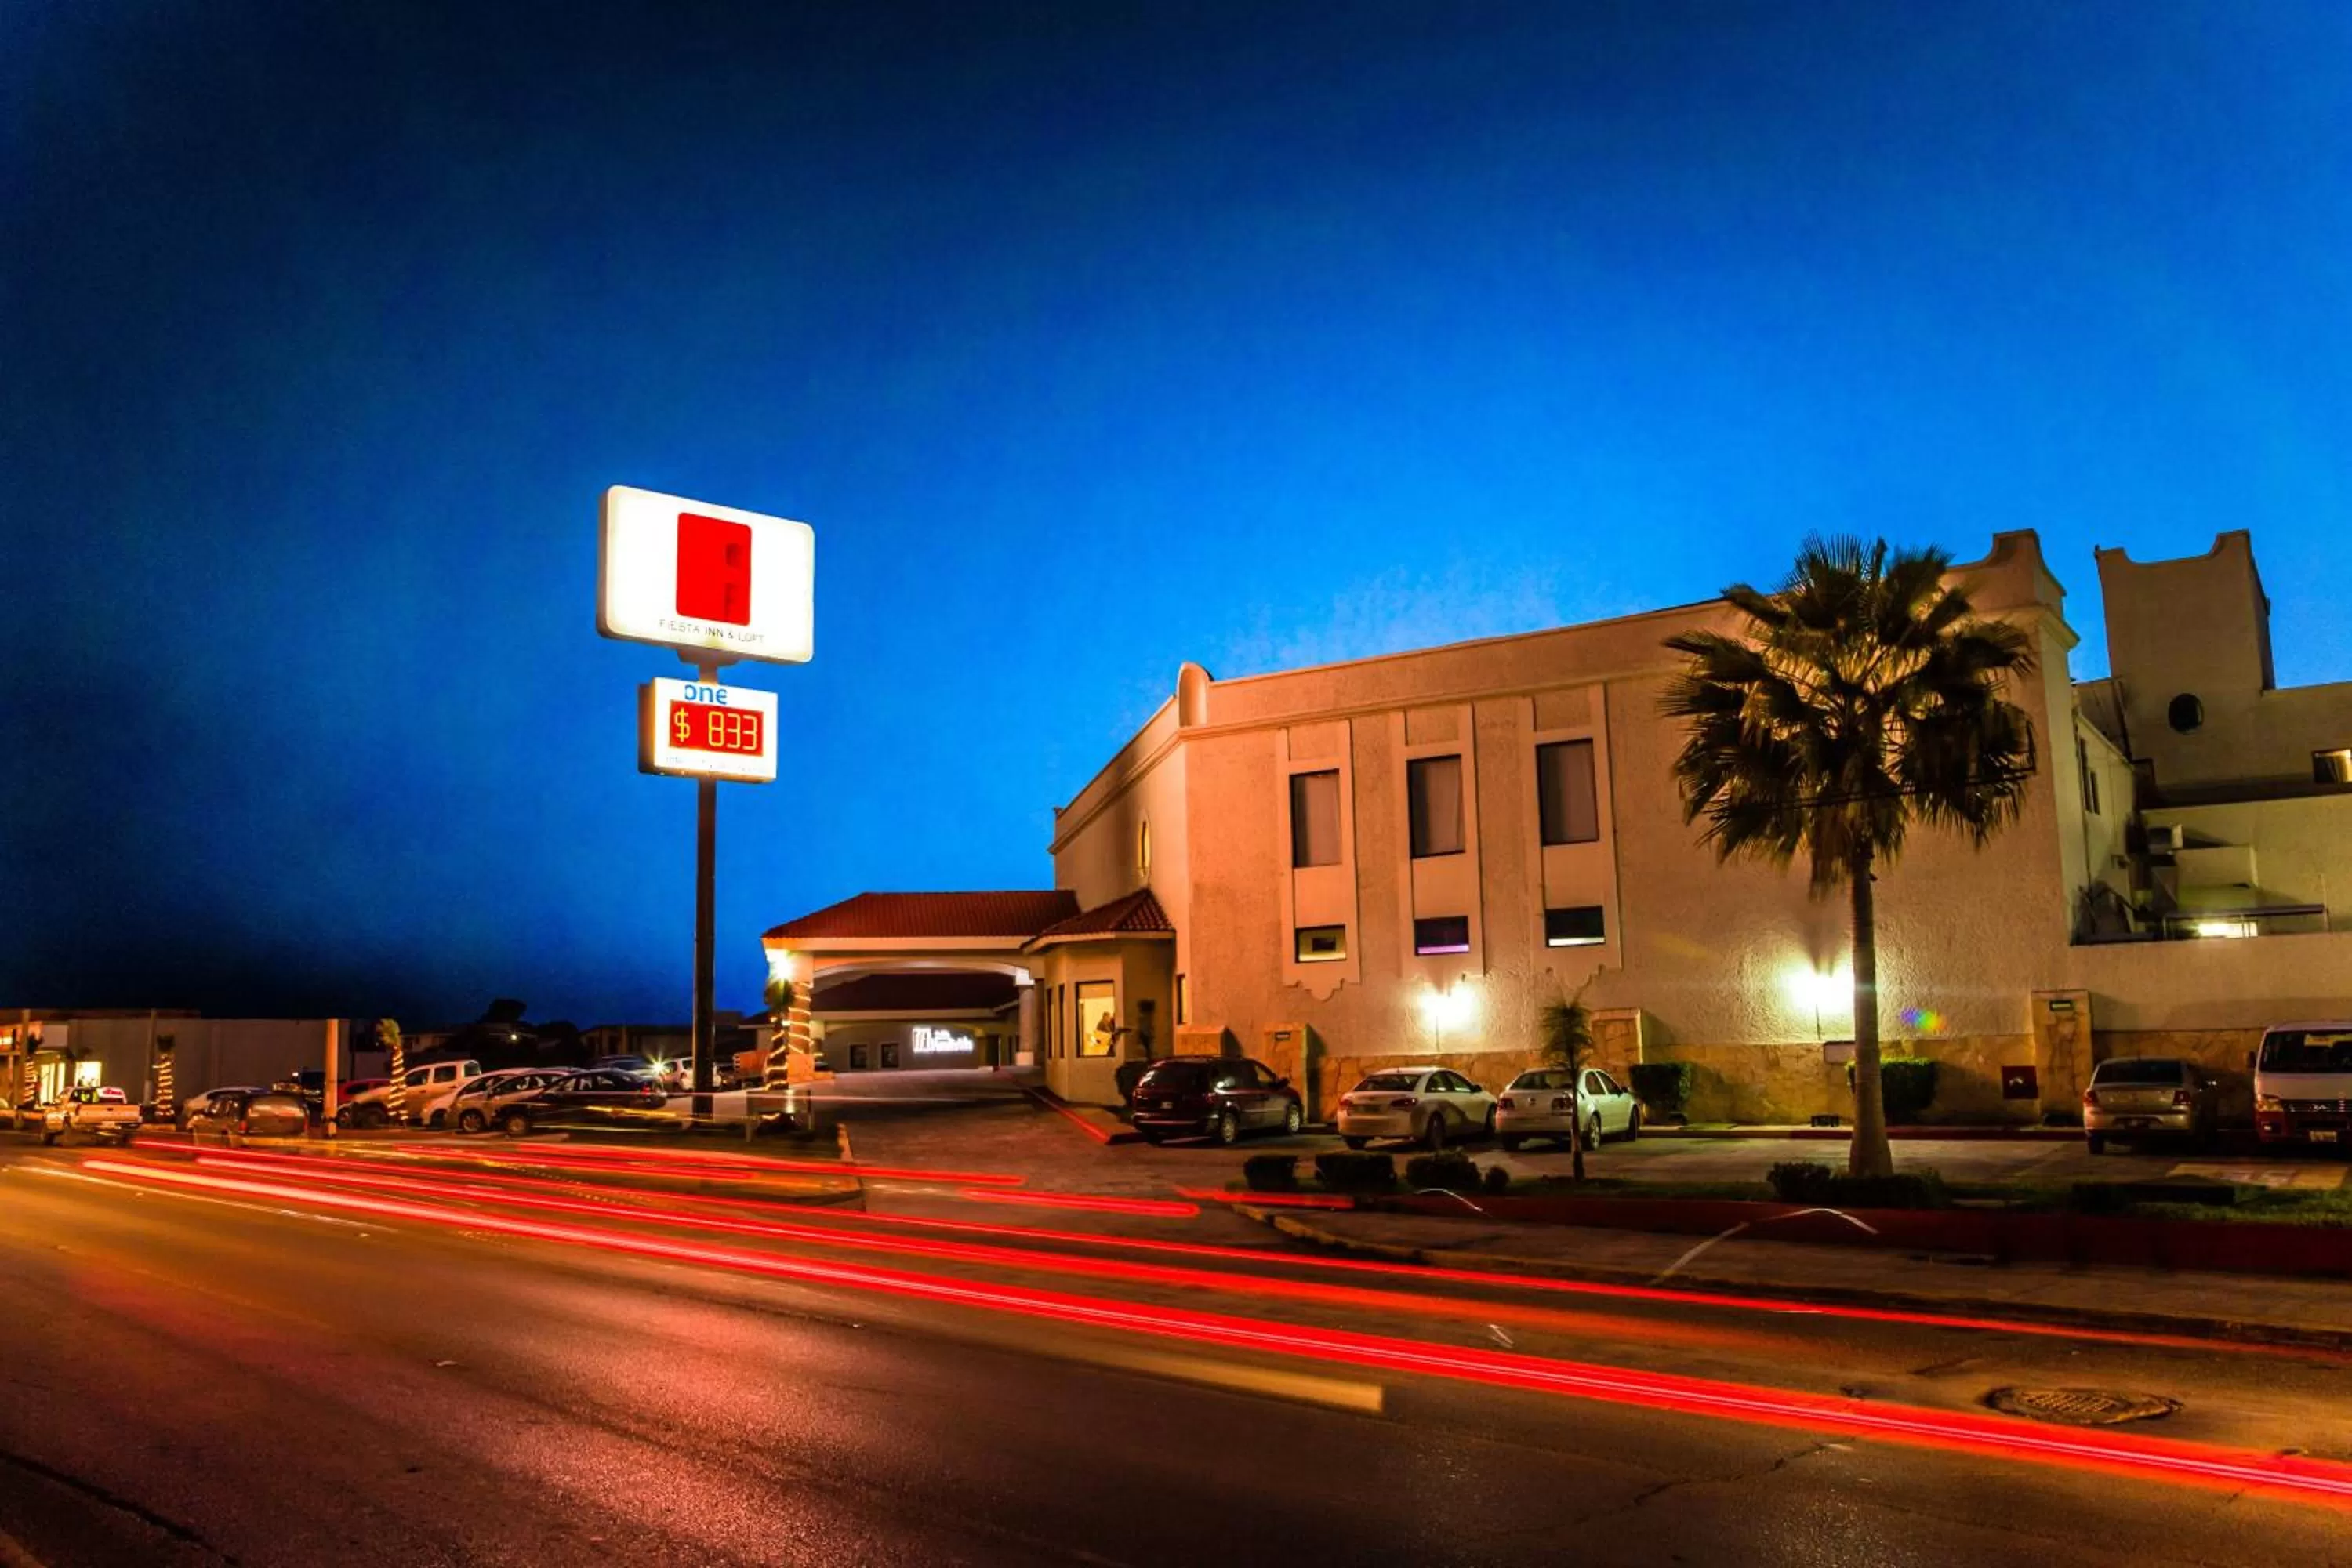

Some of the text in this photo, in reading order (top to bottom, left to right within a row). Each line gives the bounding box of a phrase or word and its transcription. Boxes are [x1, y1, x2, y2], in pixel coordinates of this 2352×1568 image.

[659, 619, 700, 634] FIESTA
[705, 626, 724, 637] INN
[684, 684, 728, 705] one
[674, 707, 757, 750] $ 833
